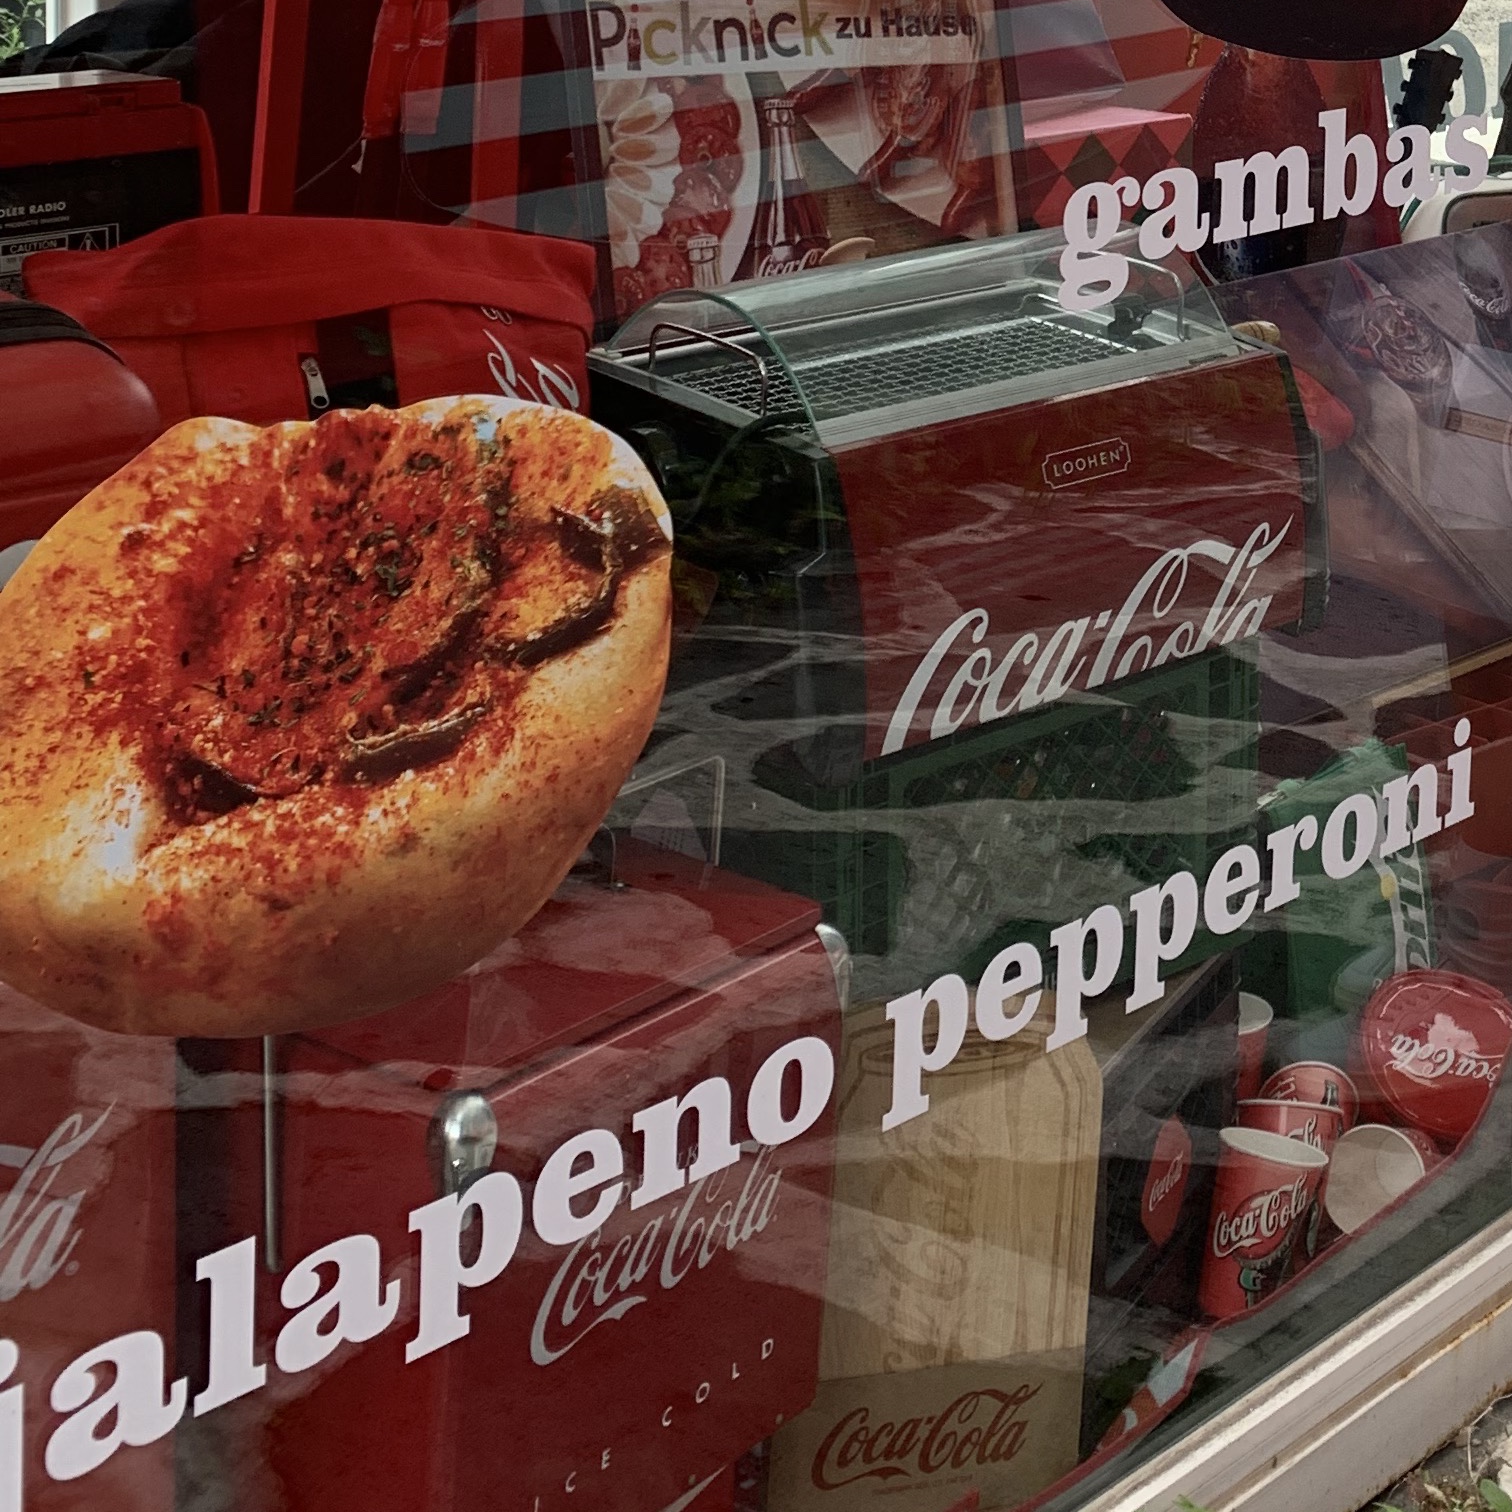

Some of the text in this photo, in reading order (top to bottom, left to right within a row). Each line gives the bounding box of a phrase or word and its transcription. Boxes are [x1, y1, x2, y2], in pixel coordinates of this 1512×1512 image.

[835, 14, 872, 40] zu
[880, 5, 978, 39] Hause
[10, 239, 58, 254] CAUTION
[29, 201, 67, 214] RADIO
[1058, 108, 1490, 313] gambas
[1053, 449, 1121, 477] LOOHEN
[881, 513, 1294, 756] Coca-Cola
[881, 718, 1477, 1133] pepperoni
[529, 1143, 784, 1366] Coca-Cola
[661, 1337, 775, 1428] COLD
[811, 1380, 1046, 1491] Coca-Cola
